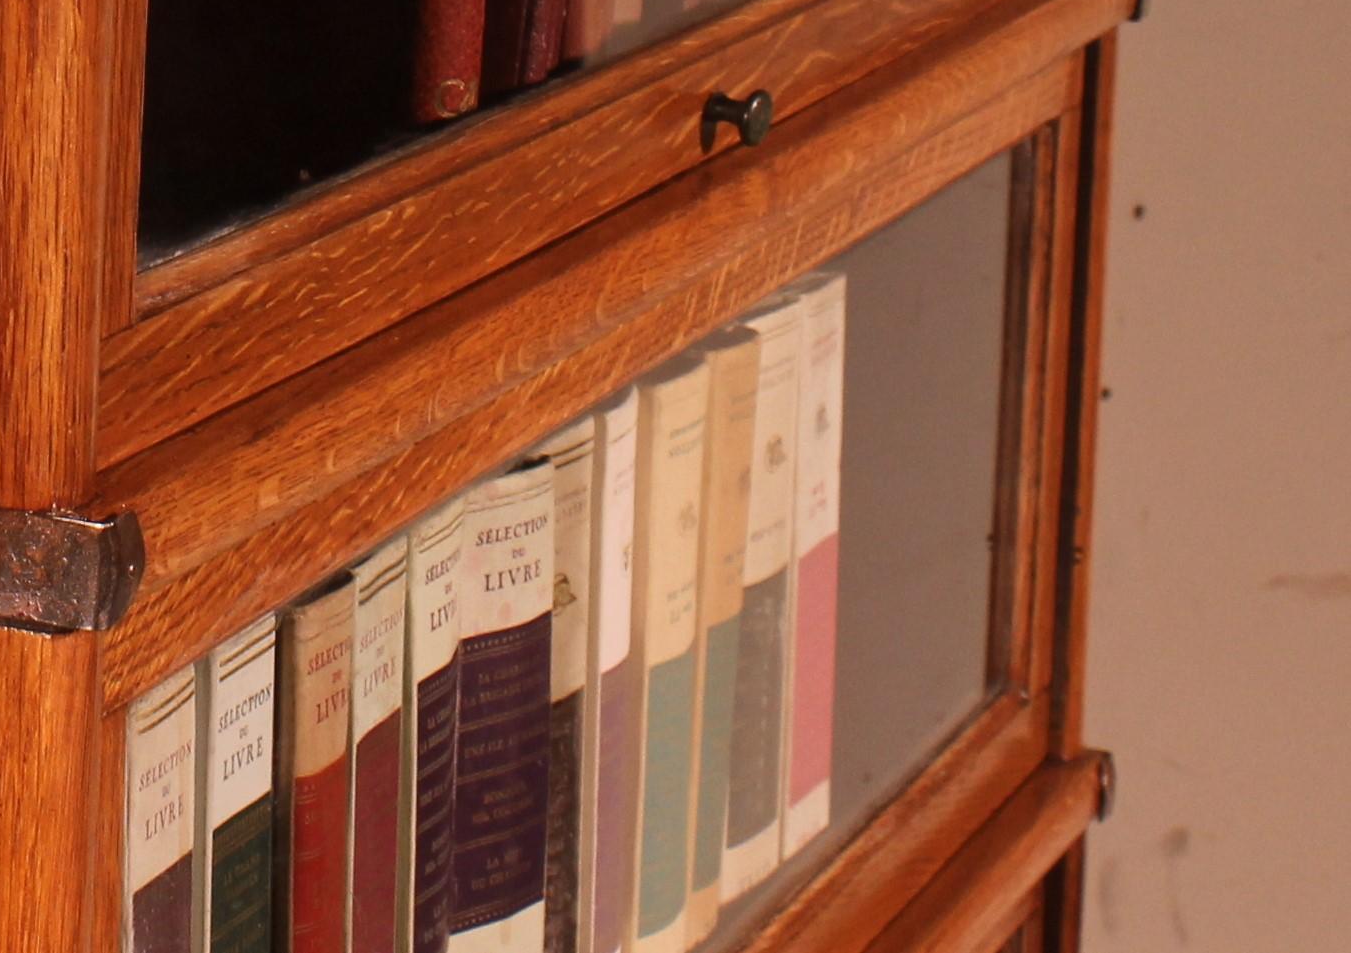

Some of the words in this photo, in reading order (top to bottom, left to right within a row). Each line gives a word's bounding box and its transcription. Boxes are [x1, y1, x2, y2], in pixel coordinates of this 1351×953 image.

[484, 558, 541, 593] LIVRE
[361, 655, 397, 698] LIVRE
[222, 735, 264, 782] LIVRE
[144, 792, 186, 841] LIVRE
